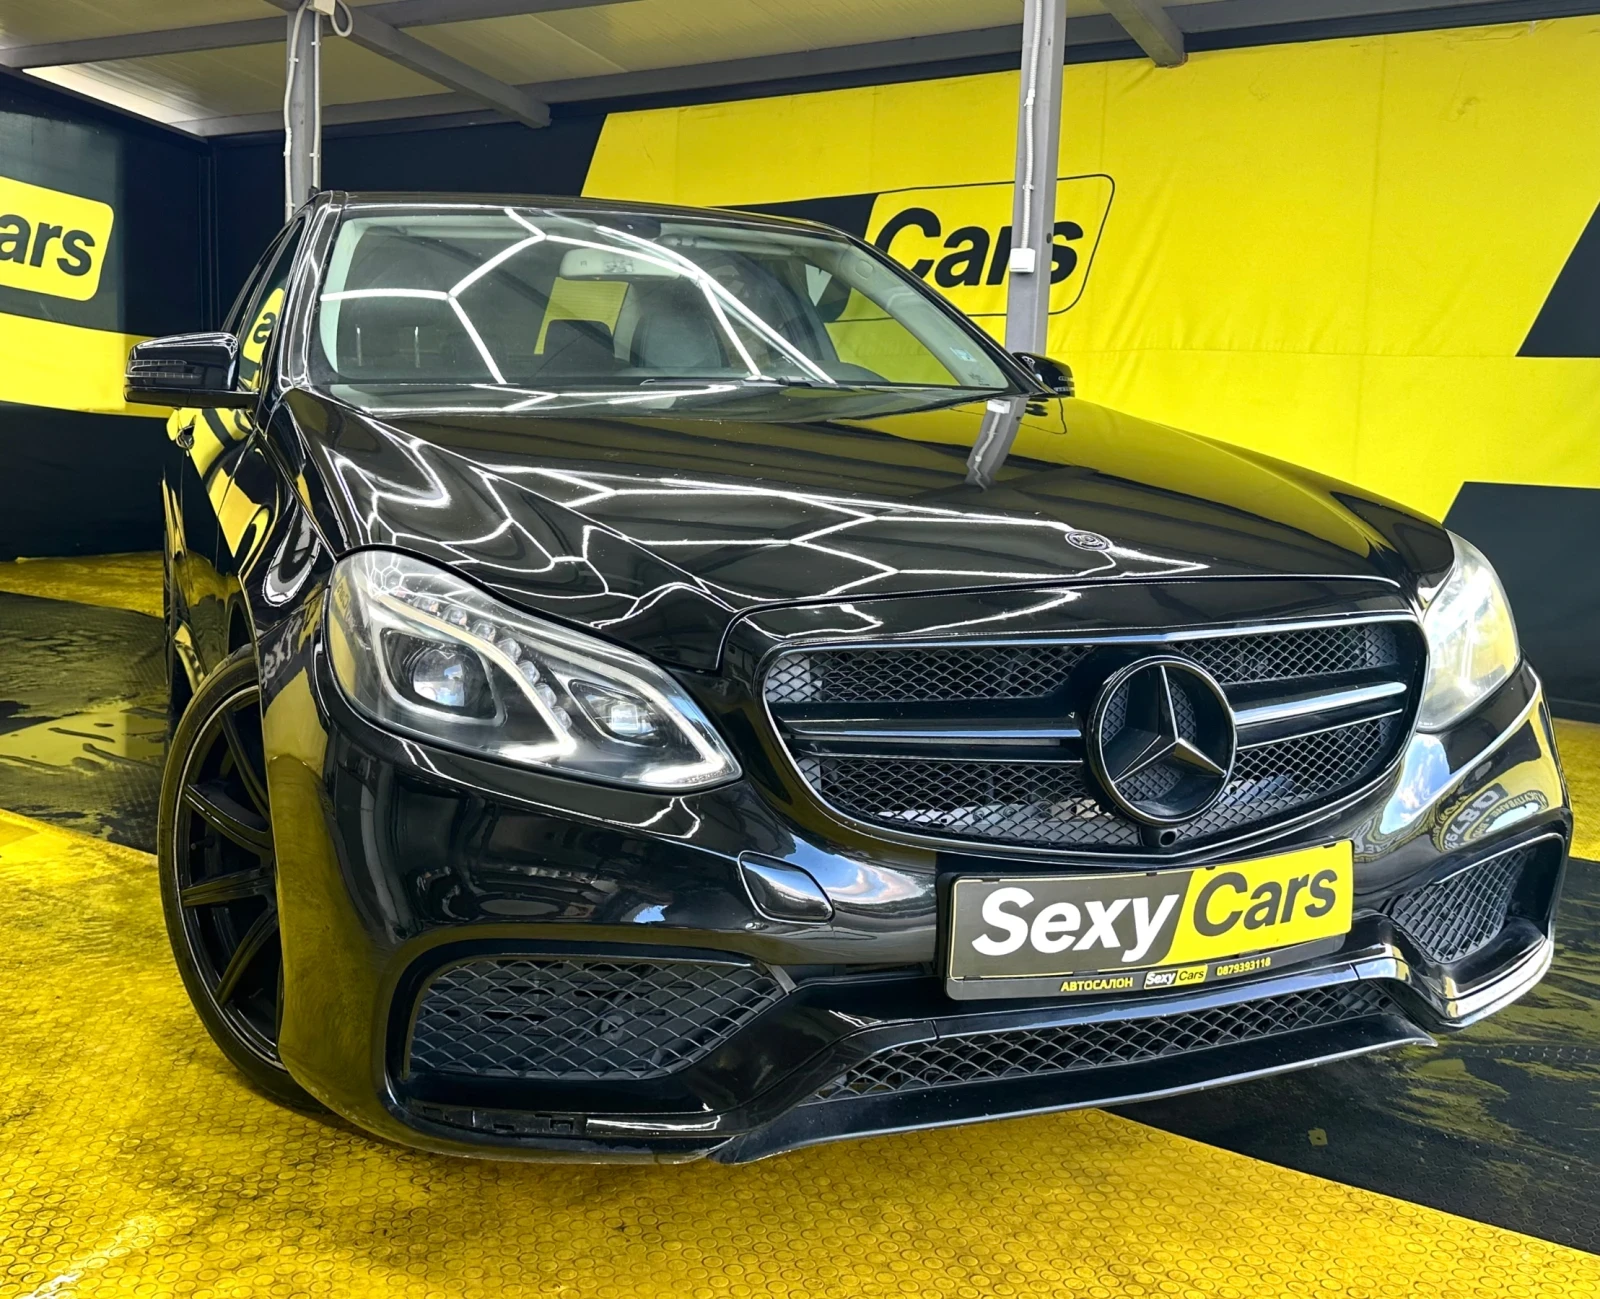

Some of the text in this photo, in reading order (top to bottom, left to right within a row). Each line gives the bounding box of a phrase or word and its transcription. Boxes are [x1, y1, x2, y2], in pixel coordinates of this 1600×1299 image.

[971, 868, 1338, 963] Sexy Cars
[1060, 957, 1271, 992] АВТОСАЛОН Sexy Cars 0879393118
